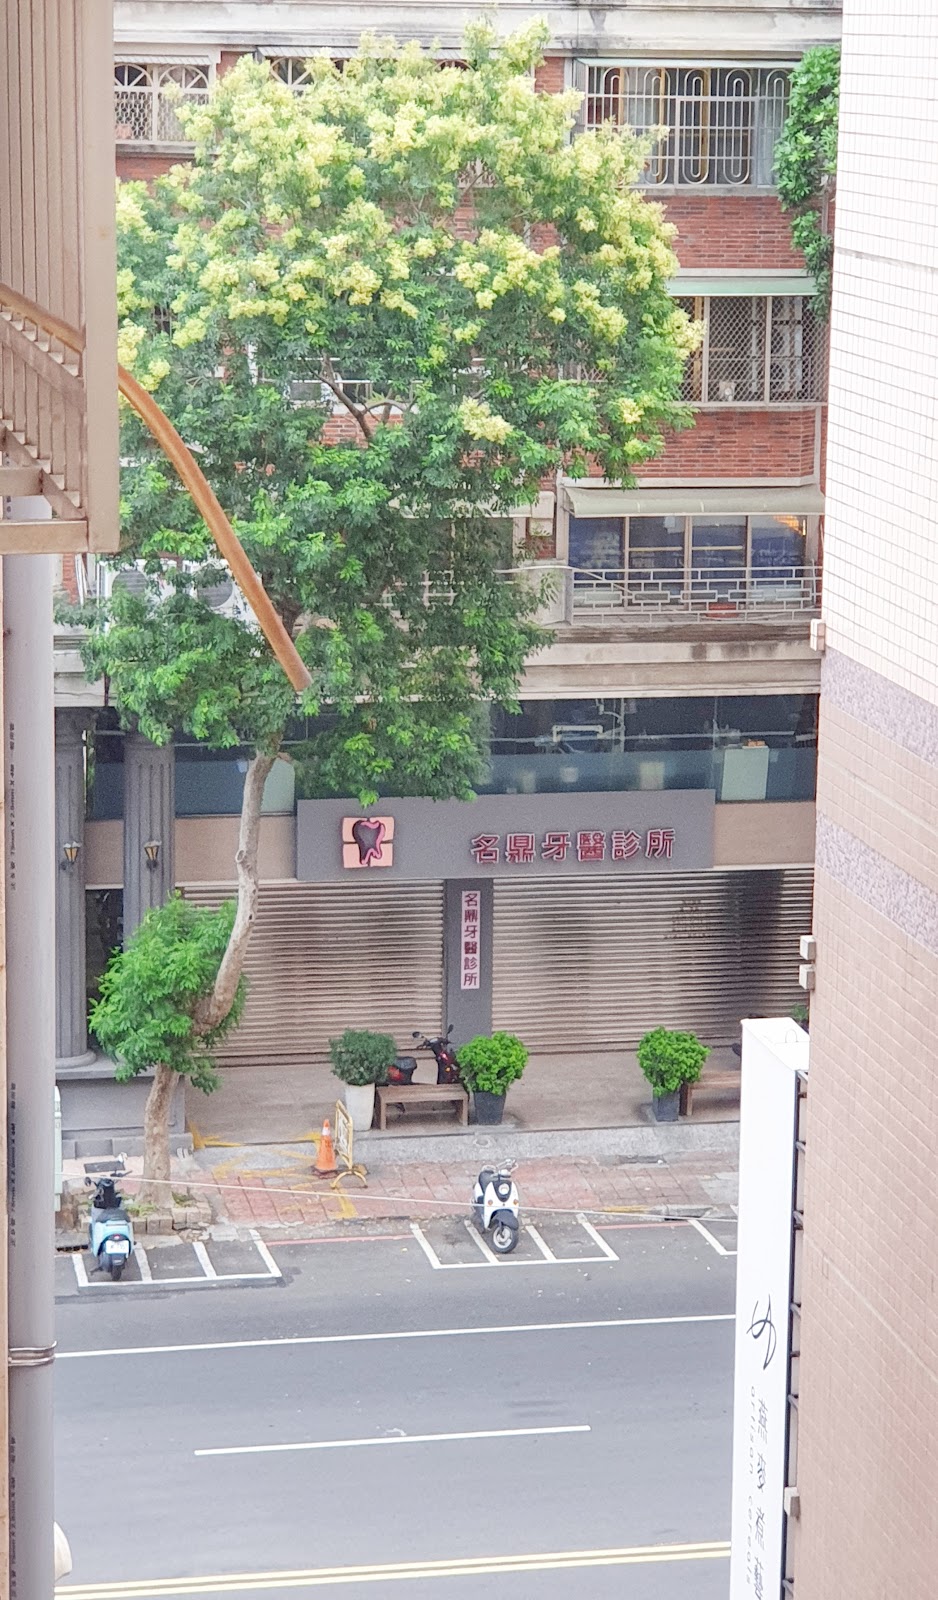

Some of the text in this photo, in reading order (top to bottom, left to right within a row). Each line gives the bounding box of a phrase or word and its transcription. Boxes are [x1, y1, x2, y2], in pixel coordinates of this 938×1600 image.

[470, 828, 676, 864] 名鼎牙醫診所
[463, 892, 478, 986] 名鼎牙醫診所
